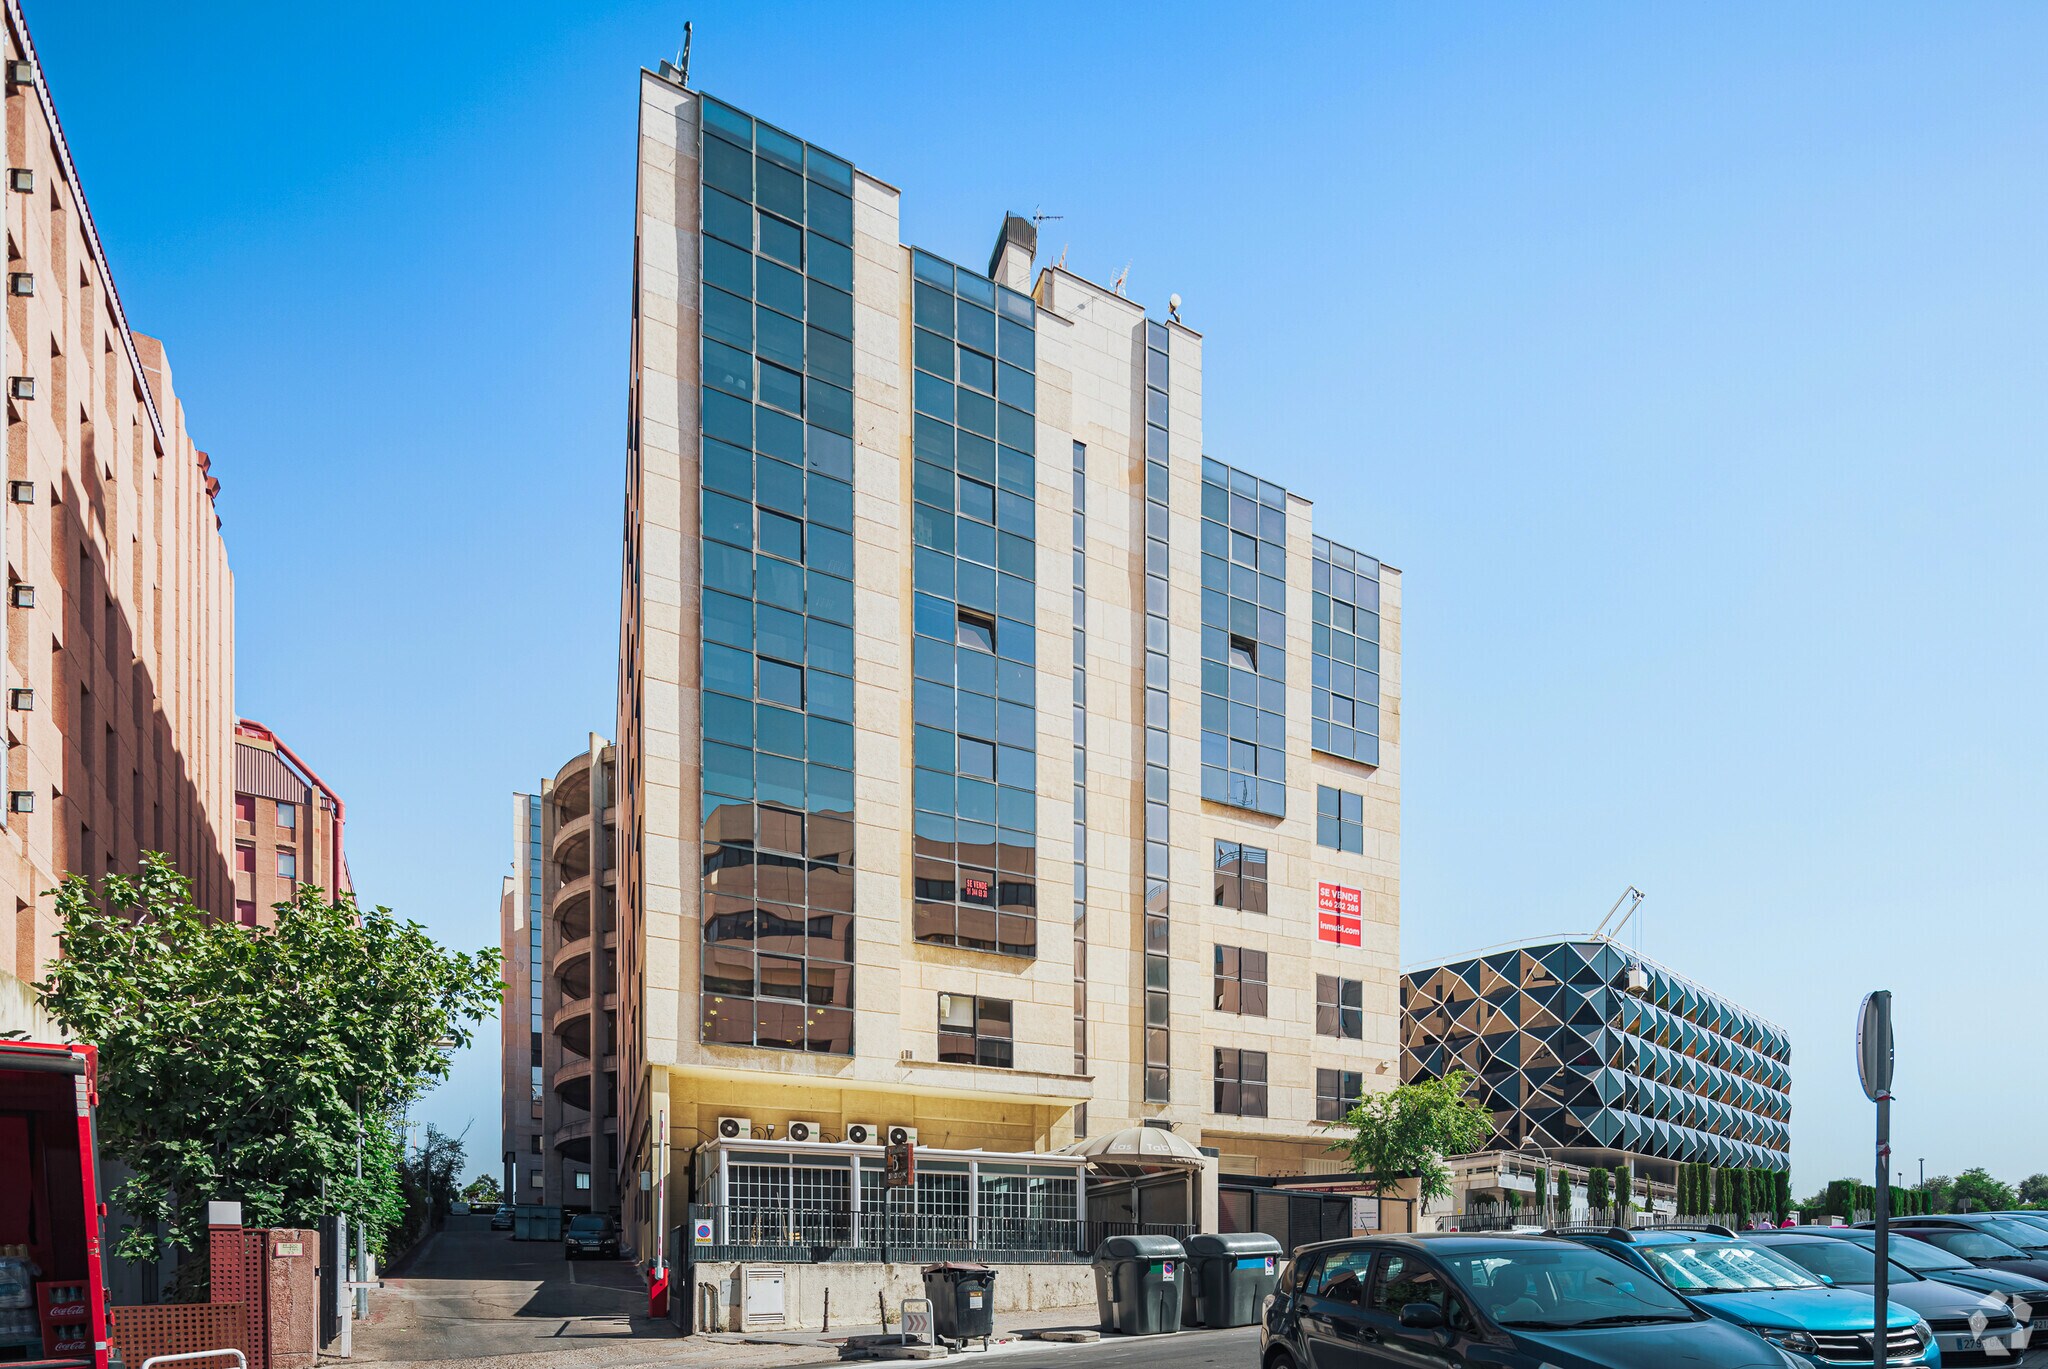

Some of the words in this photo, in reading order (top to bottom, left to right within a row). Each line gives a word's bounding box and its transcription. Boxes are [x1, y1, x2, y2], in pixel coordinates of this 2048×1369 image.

[967, 879, 972, 887] SE
[973, 881, 987, 890] VENDE
[1320, 888, 1330, 896] SE
[1331, 890, 1358, 902] VENDE
[1320, 899, 1332, 907] 646
[1112, 1142, 1132, 1150] Las
